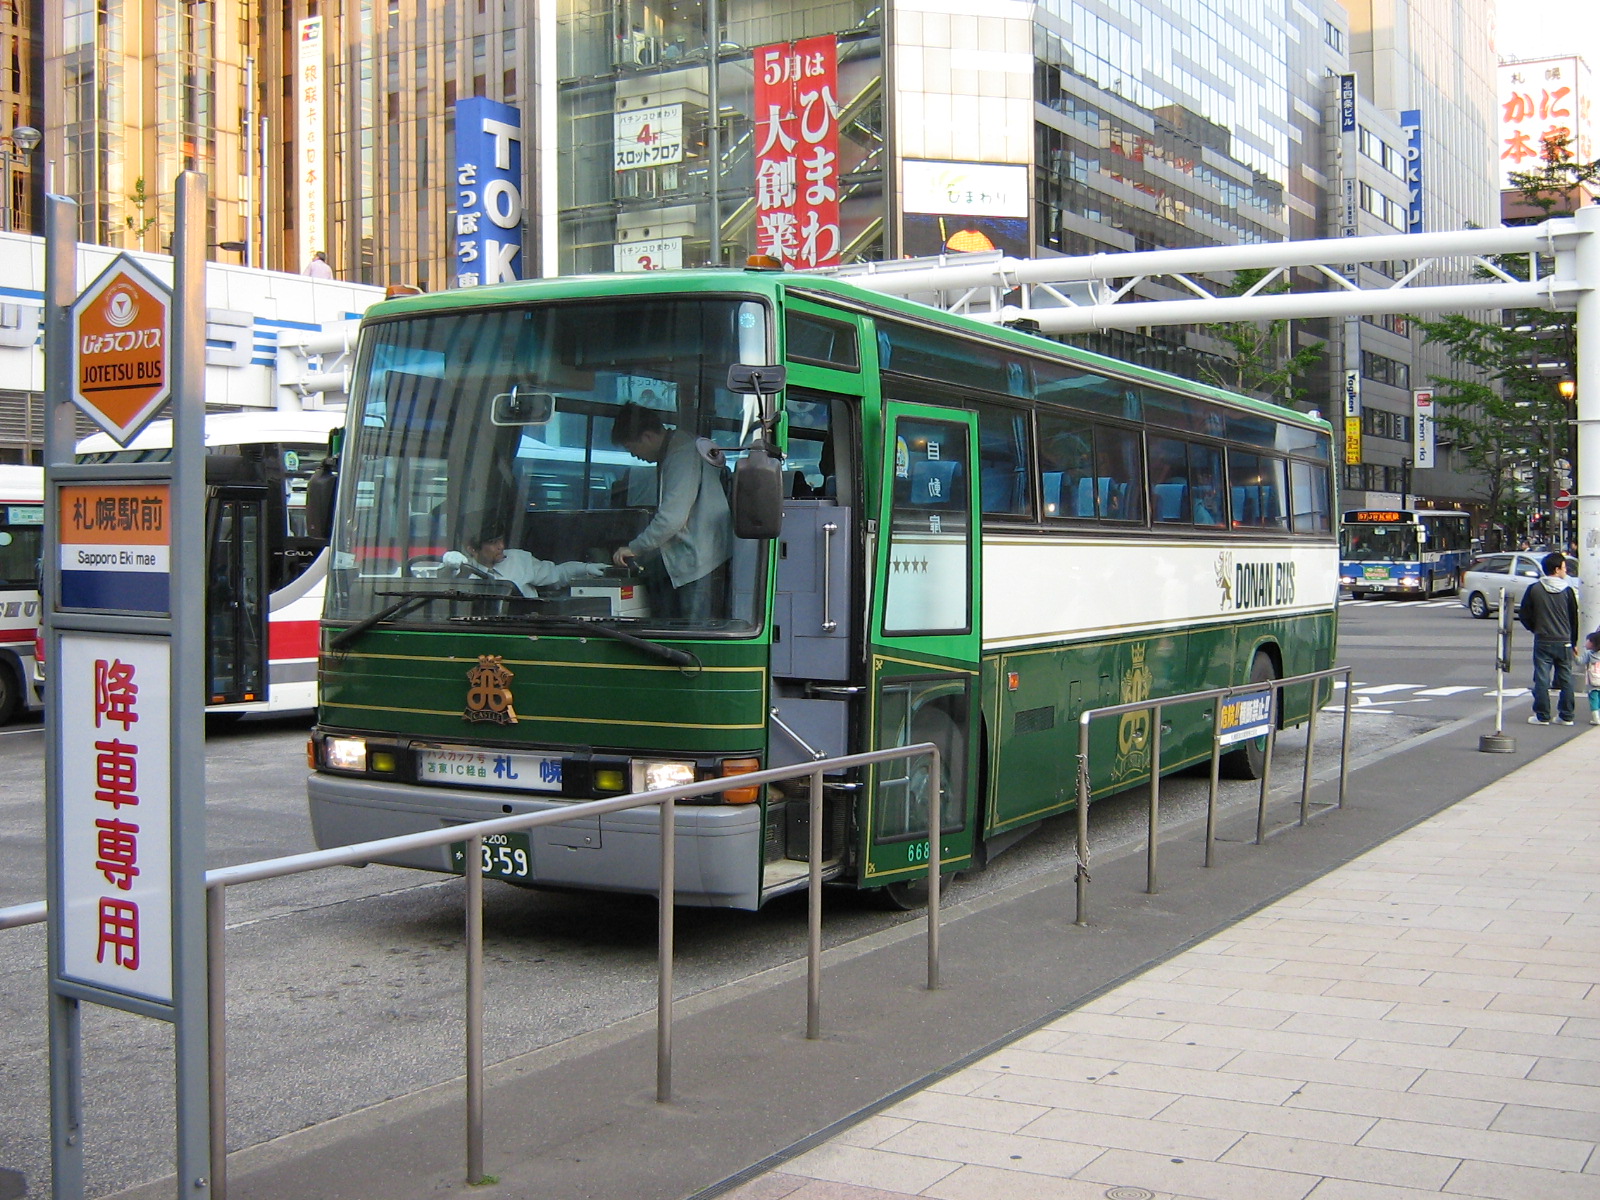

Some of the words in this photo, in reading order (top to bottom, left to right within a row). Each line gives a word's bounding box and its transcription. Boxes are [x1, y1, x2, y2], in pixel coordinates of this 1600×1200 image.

[764, 51, 826, 86] 5月は
[1511, 67, 1561, 85] 札幌
[620, 108, 678, 124] パチンコひまわり
[1343, 80, 1353, 126] 北四条ビル
[1501, 86, 1571, 123] かに
[636, 123, 660, 146] 4F
[1500, 125, 1575, 164] 本家
[617, 143, 680, 166] スロットフロア
[756, 104, 800, 270] 大創業
[799, 85, 840, 267] ひまわ
[1401, 124, 1420, 226] TOKYU
[947, 188, 1007, 205] ひまわり
[620, 242, 678, 255] パチンコひまわり
[82, 328, 162, 355] じょうてつバス
[83, 363, 134, 384] JOTETSU
[137, 360, 162, 379] BUS
[1346, 373, 1357, 413] Yagiken
[73, 495, 164, 532] 札幌駅前
[78, 551, 117, 567] Sapporo
[119, 551, 134, 565] Eki
[136, 553, 157, 566] mae
[284, 549, 314, 557] GALA
[1235, 562, 1274, 609] DONAN
[1275, 561, 1296, 605] BUS
[94, 658, 140, 971] 降車専用
